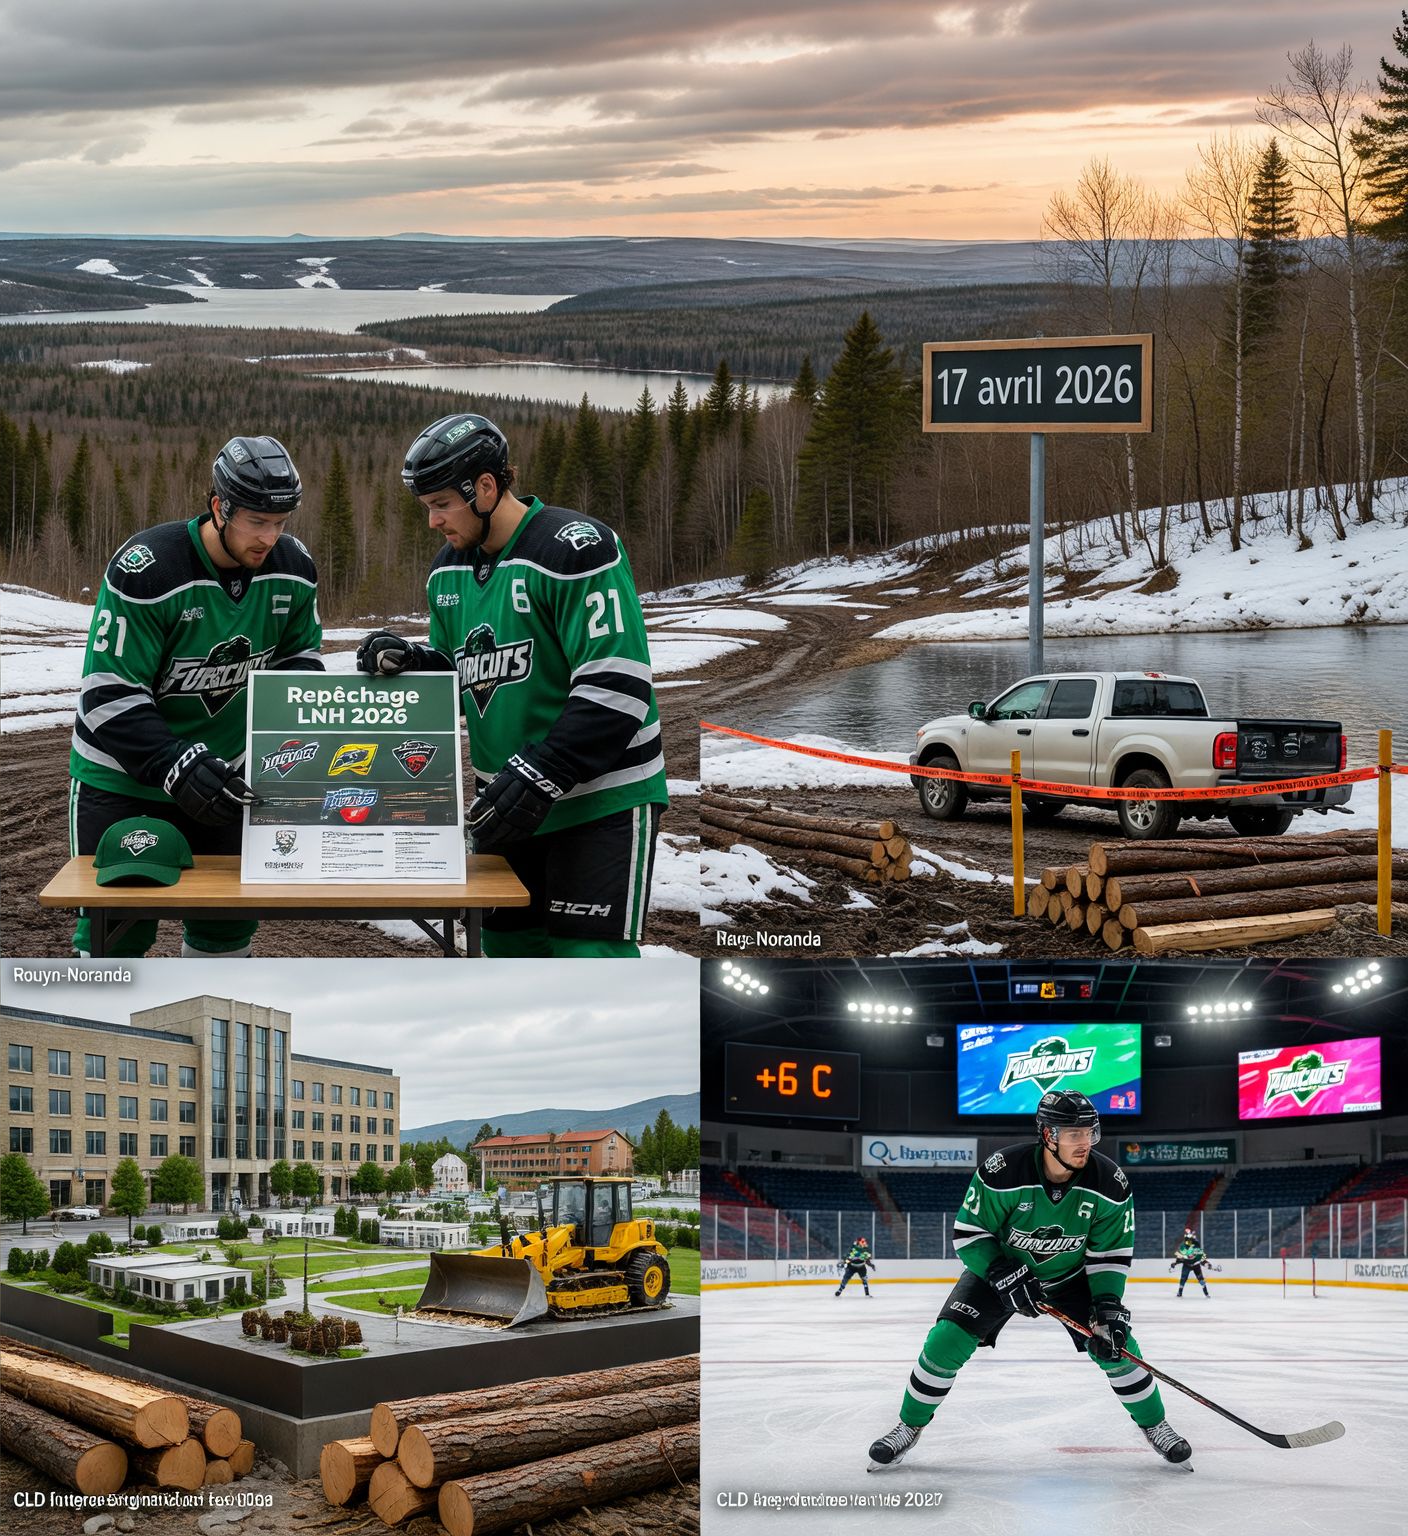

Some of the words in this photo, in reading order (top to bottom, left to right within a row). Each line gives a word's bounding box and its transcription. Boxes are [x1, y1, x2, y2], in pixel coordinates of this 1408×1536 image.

[937, 367, 968, 405] 17
[978, 364, 1042, 405] avril
[1055, 364, 1134, 405] 2026
[585, 588, 625, 640] 21
[286, 686, 420, 708] Repêchage
[297, 707, 345, 725] LNH
[351, 707, 408, 725] 2026
[756, 1061, 798, 1096] +6
[812, 1064, 832, 1098] C
